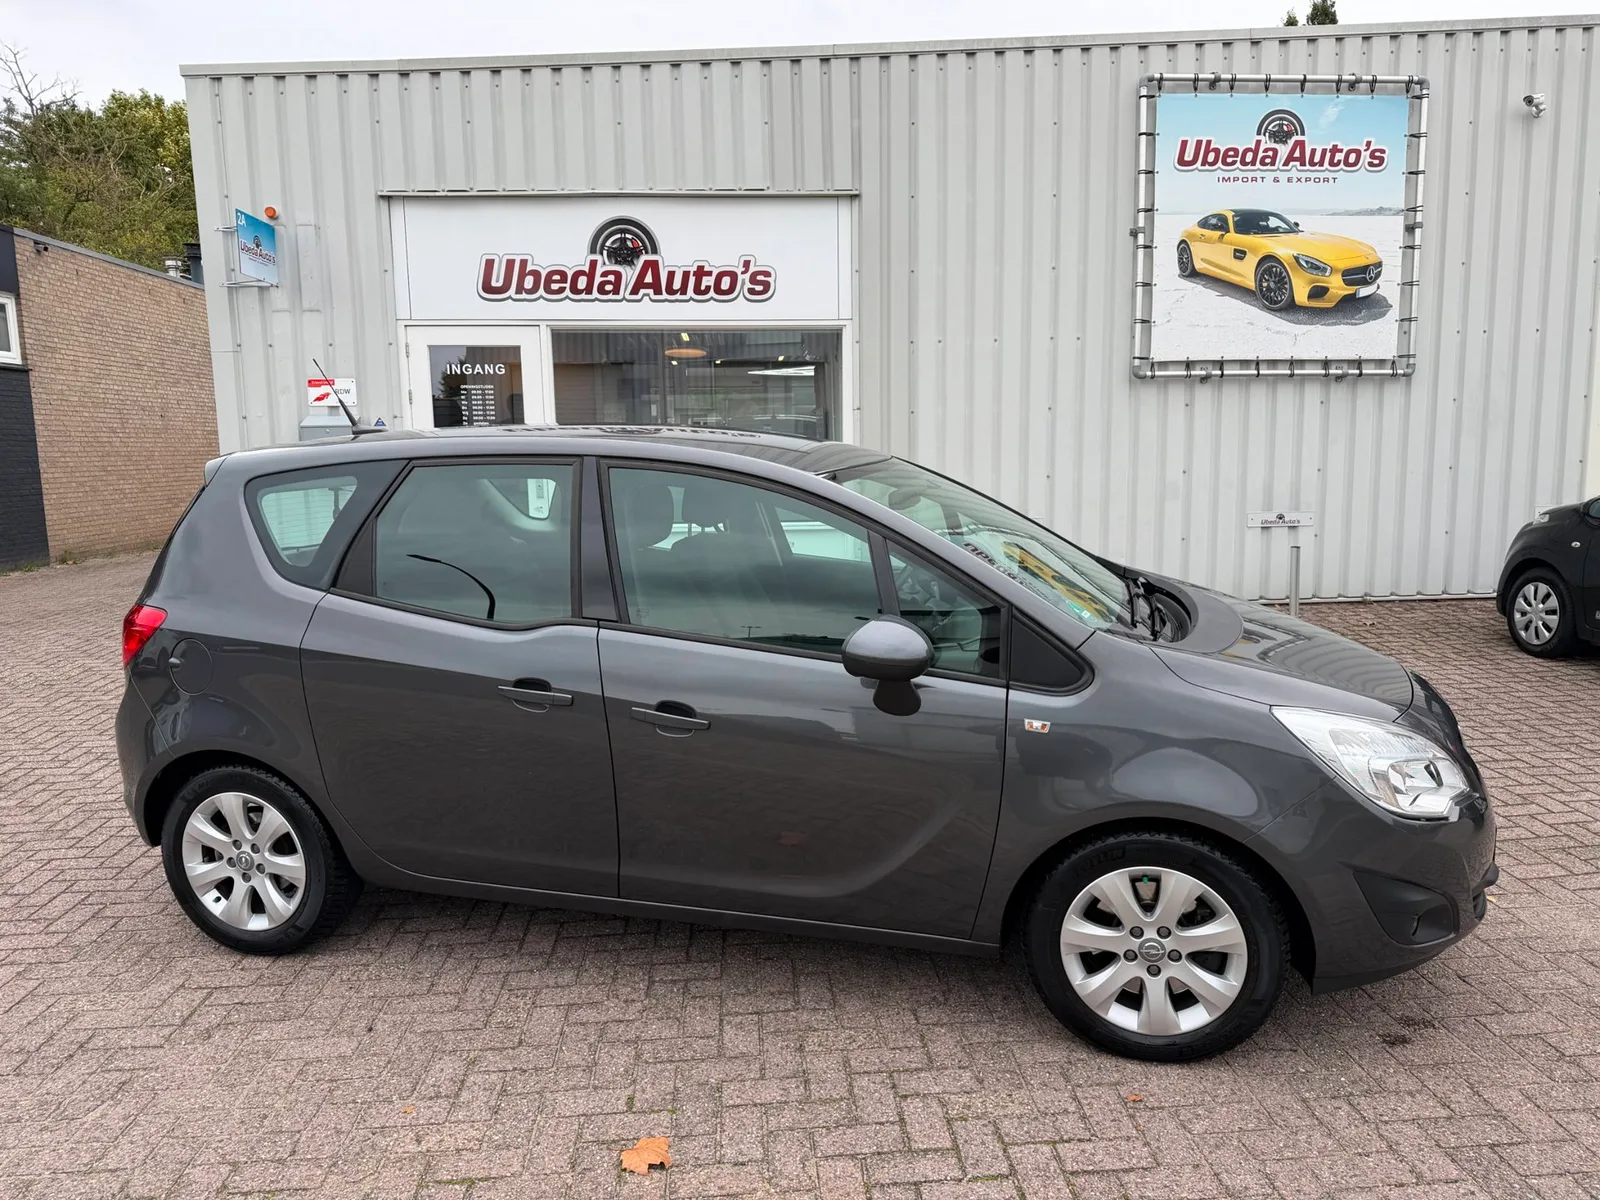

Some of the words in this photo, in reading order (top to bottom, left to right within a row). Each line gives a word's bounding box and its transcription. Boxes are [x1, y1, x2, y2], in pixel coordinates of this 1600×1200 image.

[1176, 139, 1278, 168] Ubeda
[1282, 139, 1387, 168] Auto's
[1217, 176, 1267, 184] IMPORT
[1272, 176, 1280, 184] &
[237, 212, 247, 227] 2A
[240, 240, 259, 257] Ubeda
[258, 248, 276, 264] Auto's
[480, 258, 623, 297] Ubeda
[628, 258, 772, 297] Auto's
[446, 363, 506, 375] INGANG
